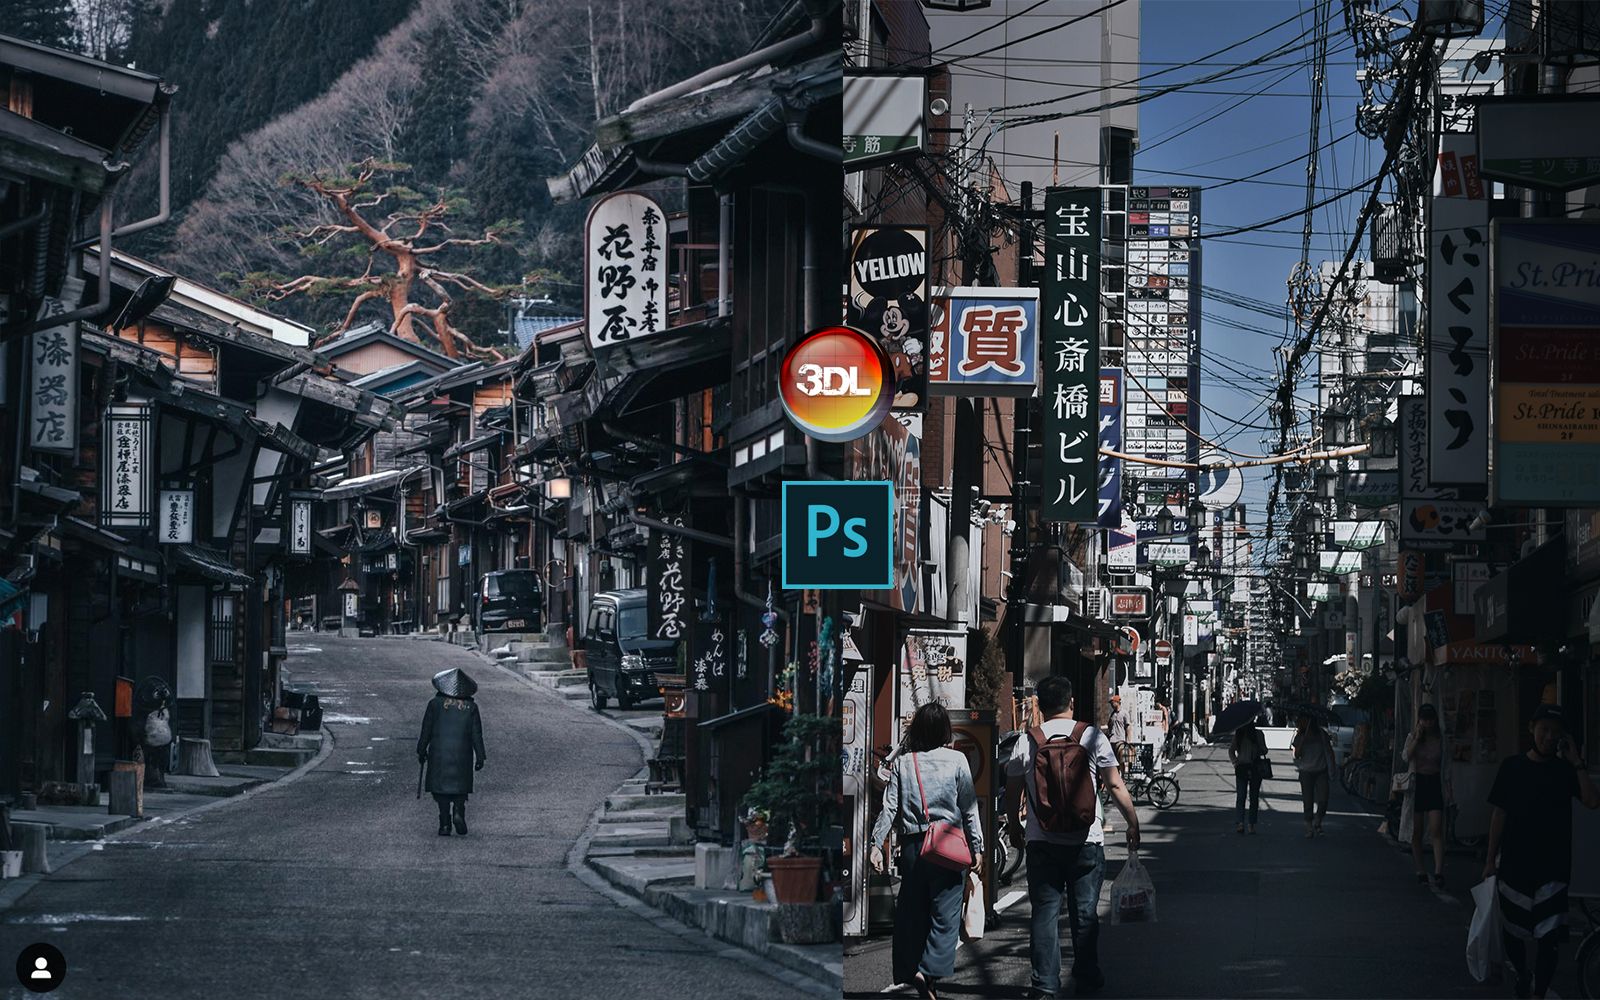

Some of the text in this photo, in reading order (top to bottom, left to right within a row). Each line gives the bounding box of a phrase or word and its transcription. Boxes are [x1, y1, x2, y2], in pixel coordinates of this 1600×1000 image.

[640, 206, 661, 272] 奈良井宿
[855, 251, 926, 283] YELLOW
[597, 223, 637, 342] 花野屋
[957, 305, 1028, 377] 質
[1052, 203, 1091, 506] 宝山心斎橋ビル
[1513, 401, 1586, 420] St.Pride
[1173, 521, 1187, 531] ビル
[656, 561, 687, 639] 花野屋
[711, 628, 725, 677] めんば
[911, 665, 954, 682] 免税
